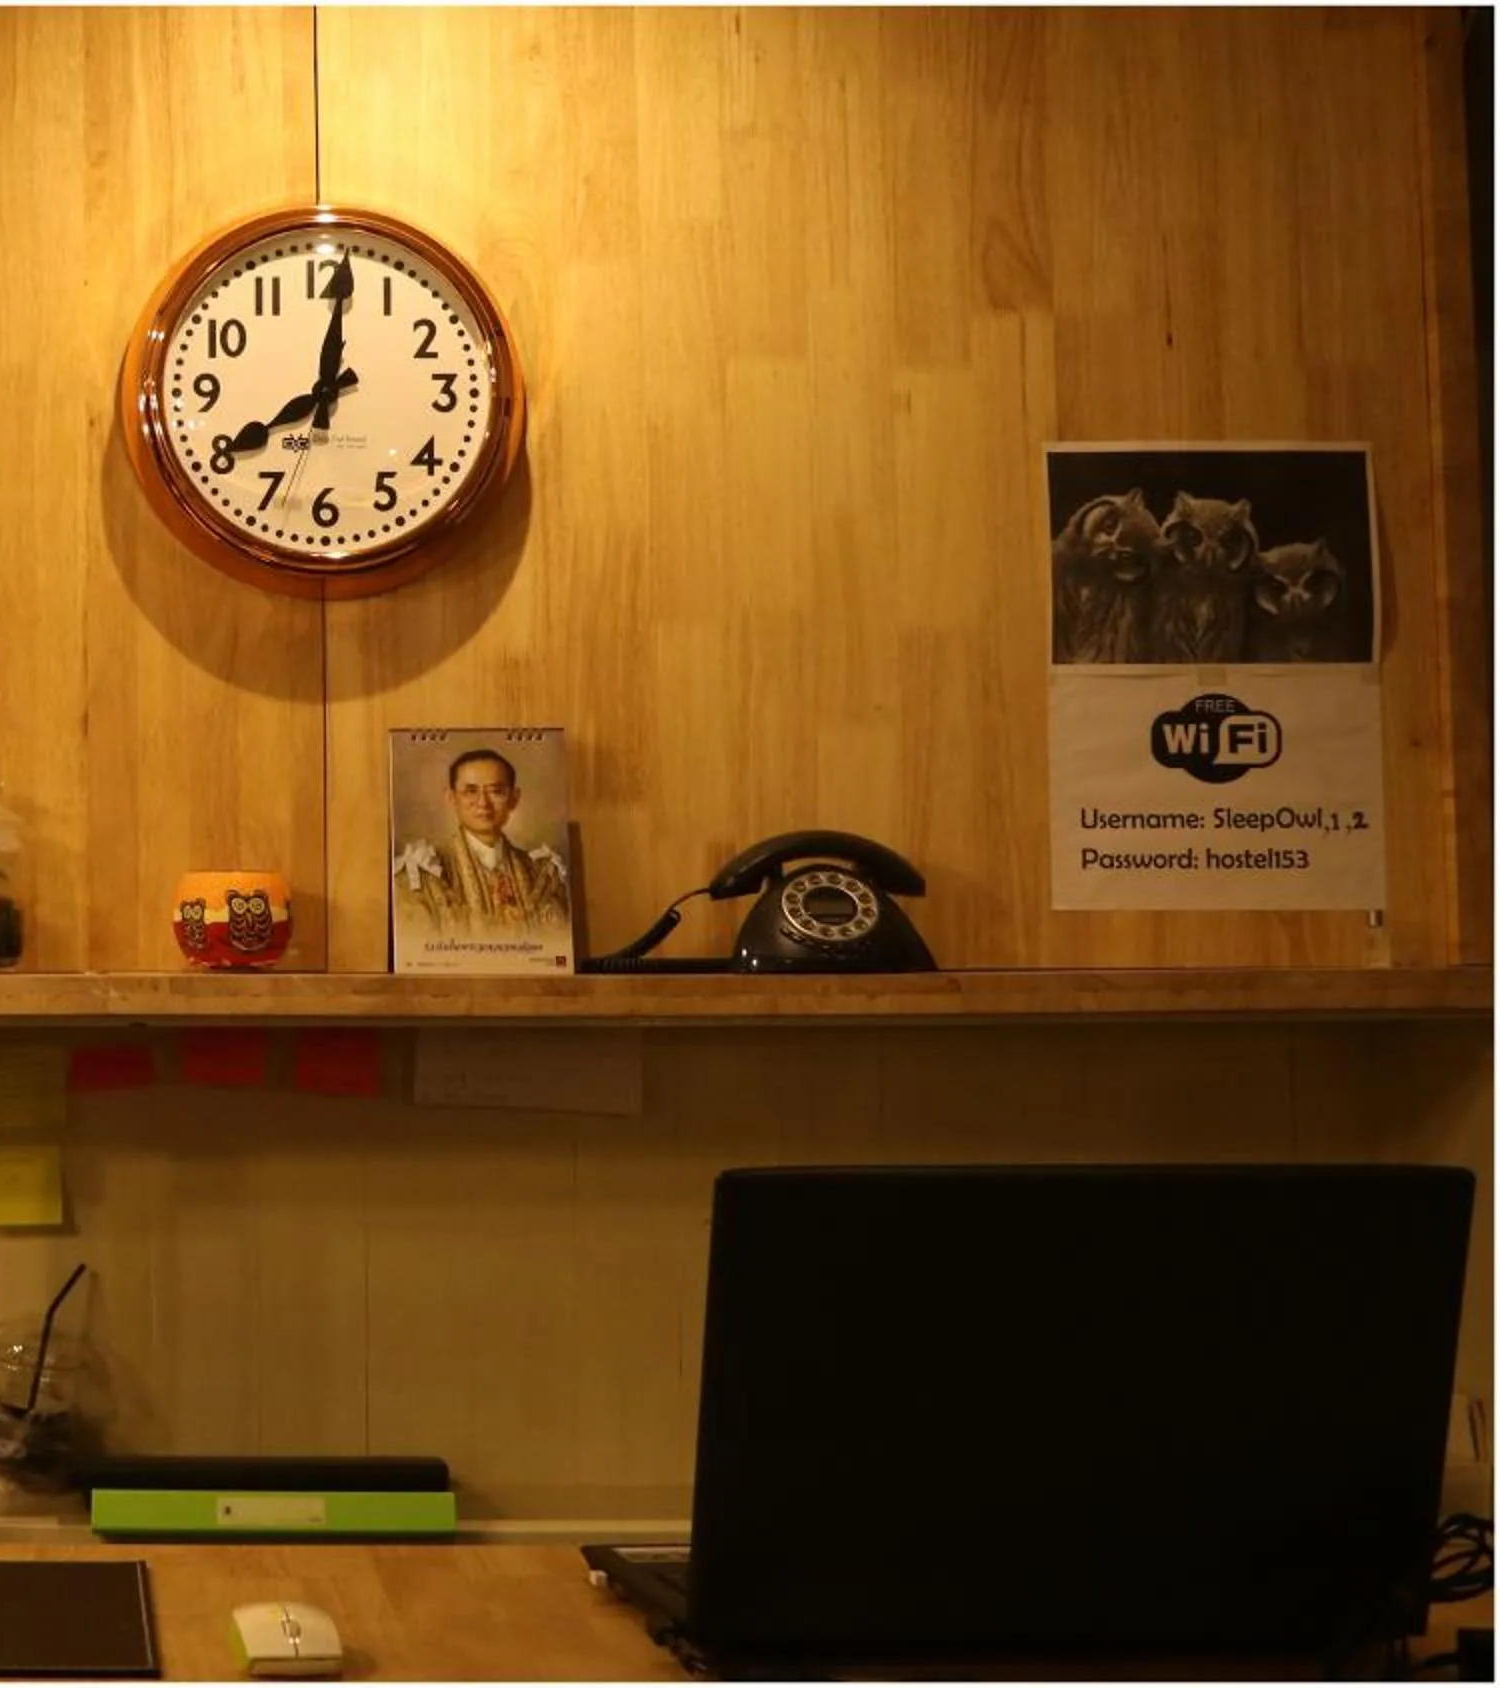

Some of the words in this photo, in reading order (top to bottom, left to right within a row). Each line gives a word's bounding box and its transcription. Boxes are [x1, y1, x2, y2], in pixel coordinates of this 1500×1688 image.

[255, 277, 280, 316] 11
[383, 277, 392, 316] 1
[208, 319, 247, 359] 10
[413, 319, 439, 359] 2
[193, 373, 221, 413] 9
[431, 373, 458, 413] 3
[209, 435, 236, 475] 8
[410, 436, 443, 476] 4
[257, 471, 286, 512] 7
[311, 487, 340, 528] 6
[373, 471, 398, 513] 5
[1194, 699, 1236, 713] FREE
[1080, 808, 1206, 829] Username:
[1080, 848, 1199, 870] Password:
[1206, 848, 1310, 870] hostel153
